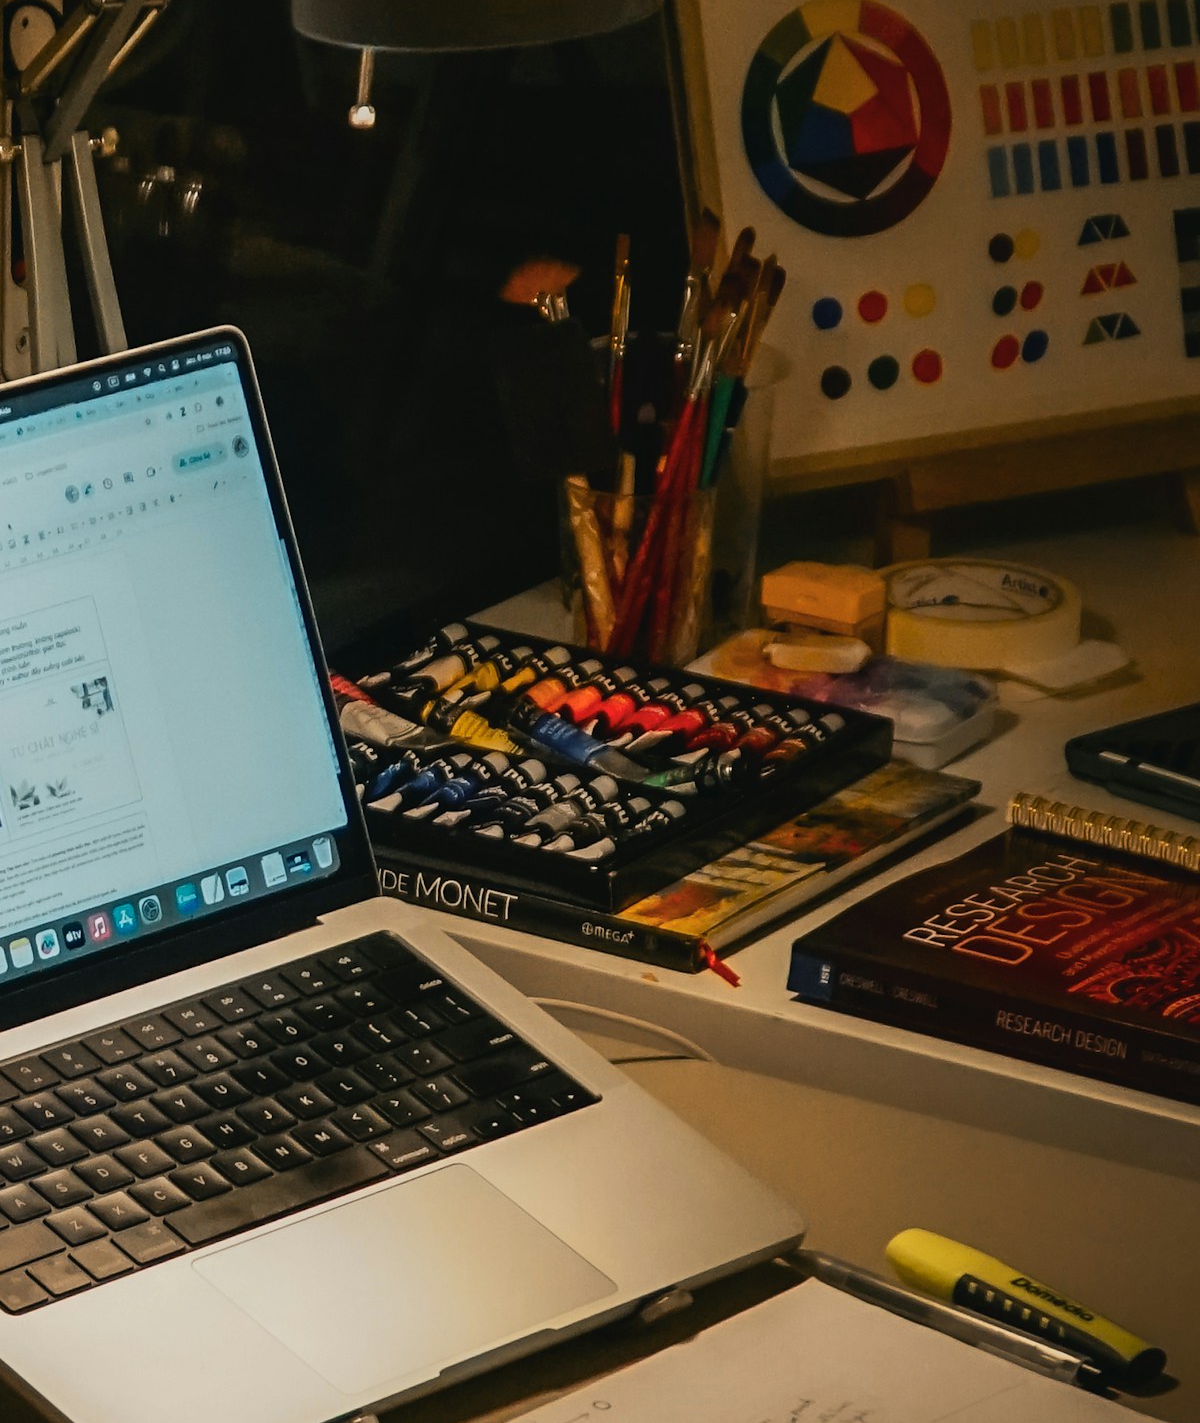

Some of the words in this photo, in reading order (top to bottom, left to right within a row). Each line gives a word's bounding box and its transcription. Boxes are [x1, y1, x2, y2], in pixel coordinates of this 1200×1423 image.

[414, 871, 518, 920] MONET
[902, 853, 1100, 947] RESEARCH
[951, 866, 1170, 965] DESIGN
[995, 1008, 1072, 1046] RESEARCH
[1074, 1027, 1128, 1059] DESIGN
